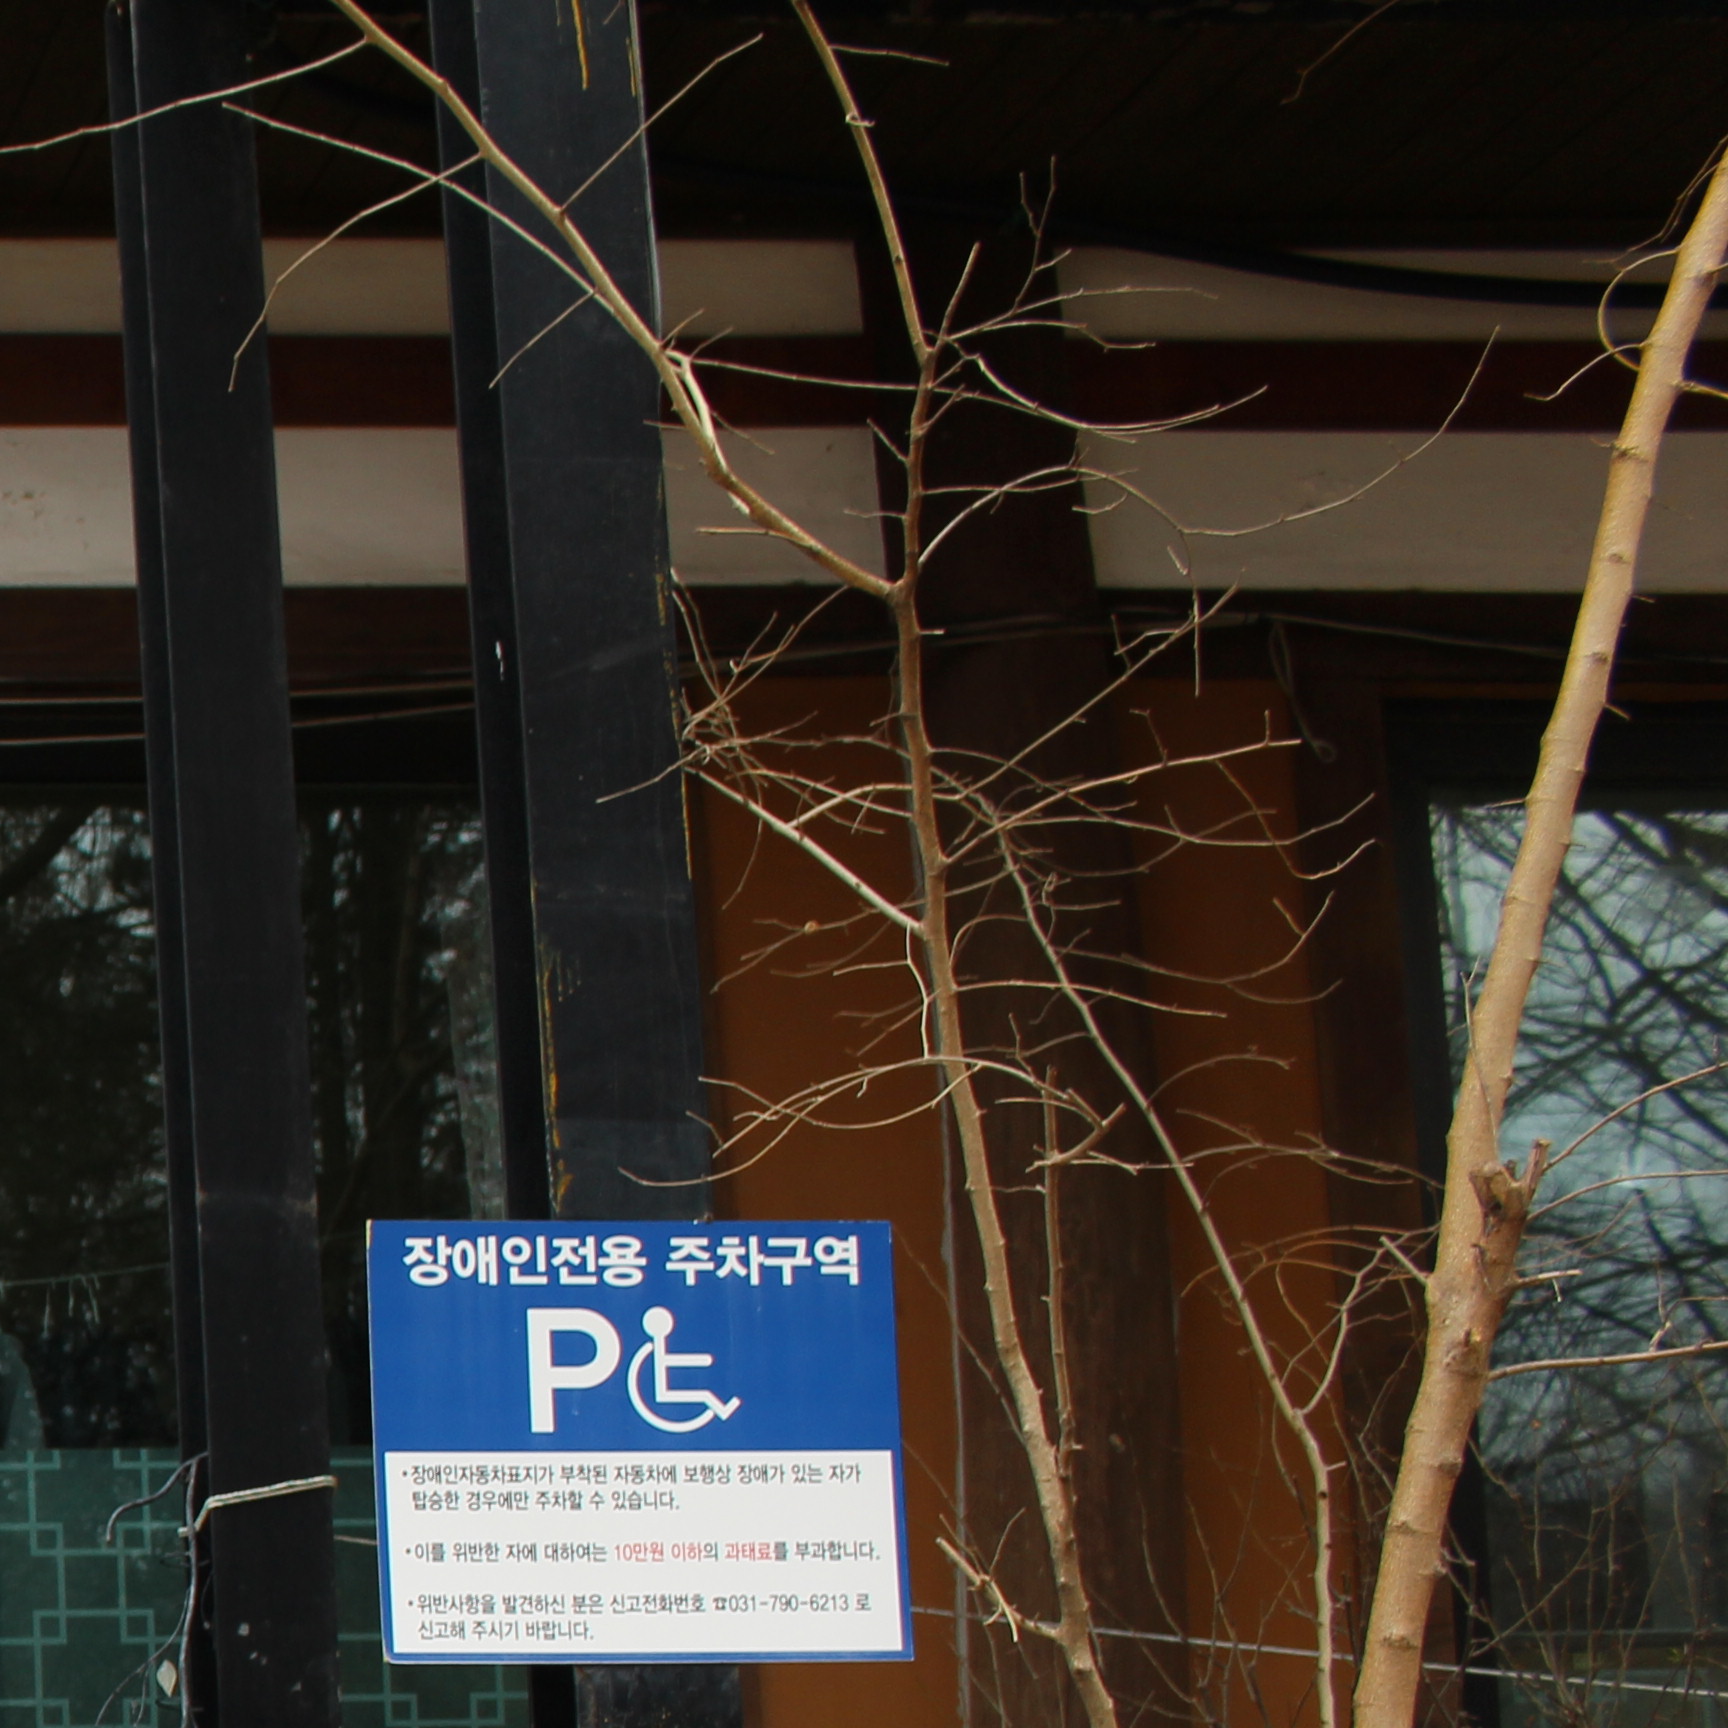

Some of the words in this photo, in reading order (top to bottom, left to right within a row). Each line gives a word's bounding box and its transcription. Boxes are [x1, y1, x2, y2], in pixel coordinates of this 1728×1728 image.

[402, 1236, 647, 1286] 장애인전용
[665, 1235, 860, 1286] 주차구역
[526, 1307, 622, 1434] P
[410, 1464, 555, 1485] 장애인자동차표지가
[560, 1465, 608, 1485] 부착된
[614, 1464, 677, 1485] 자동차에
[683, 1464, 732, 1485] 보행상
[737, 1464, 786, 1484] 장애가
[791, 1464, 823, 1484] 있는
[829, 1464, 861, 1484] 자가
[412, 1491, 459, 1511] 탑승한
[466, 1491, 529, 1511] 경우에만
[535, 1491, 583, 1511] 주차할
[589, 1492, 605, 1511] 수
[611, 1490, 680, 1510] 있습니다.
[414, 1543, 446, 1562] 이를
[452, 1542, 500, 1562] 위반한
[506, 1542, 537, 1562] 자에
[543, 1542, 607, 1562] 대하여는
[614, 1542, 665, 1562] 10만원
[671, 1542, 719, 1562] 이하의
[724, 1541, 788, 1562] 과태료를
[795, 1541, 881, 1561] 부과합니다.
[417, 1594, 496, 1614] 위반사항을
[502, 1594, 566, 1614] 발견하신
[572, 1594, 604, 1614] 분은
[610, 1593, 706, 1614] 신고전화번호
[855, 1593, 872, 1612] 로
[418, 1621, 466, 1640] 신고해
[471, 1621, 519, 1640] 주시기
[525, 1621, 595, 1640] 바랍니다.
